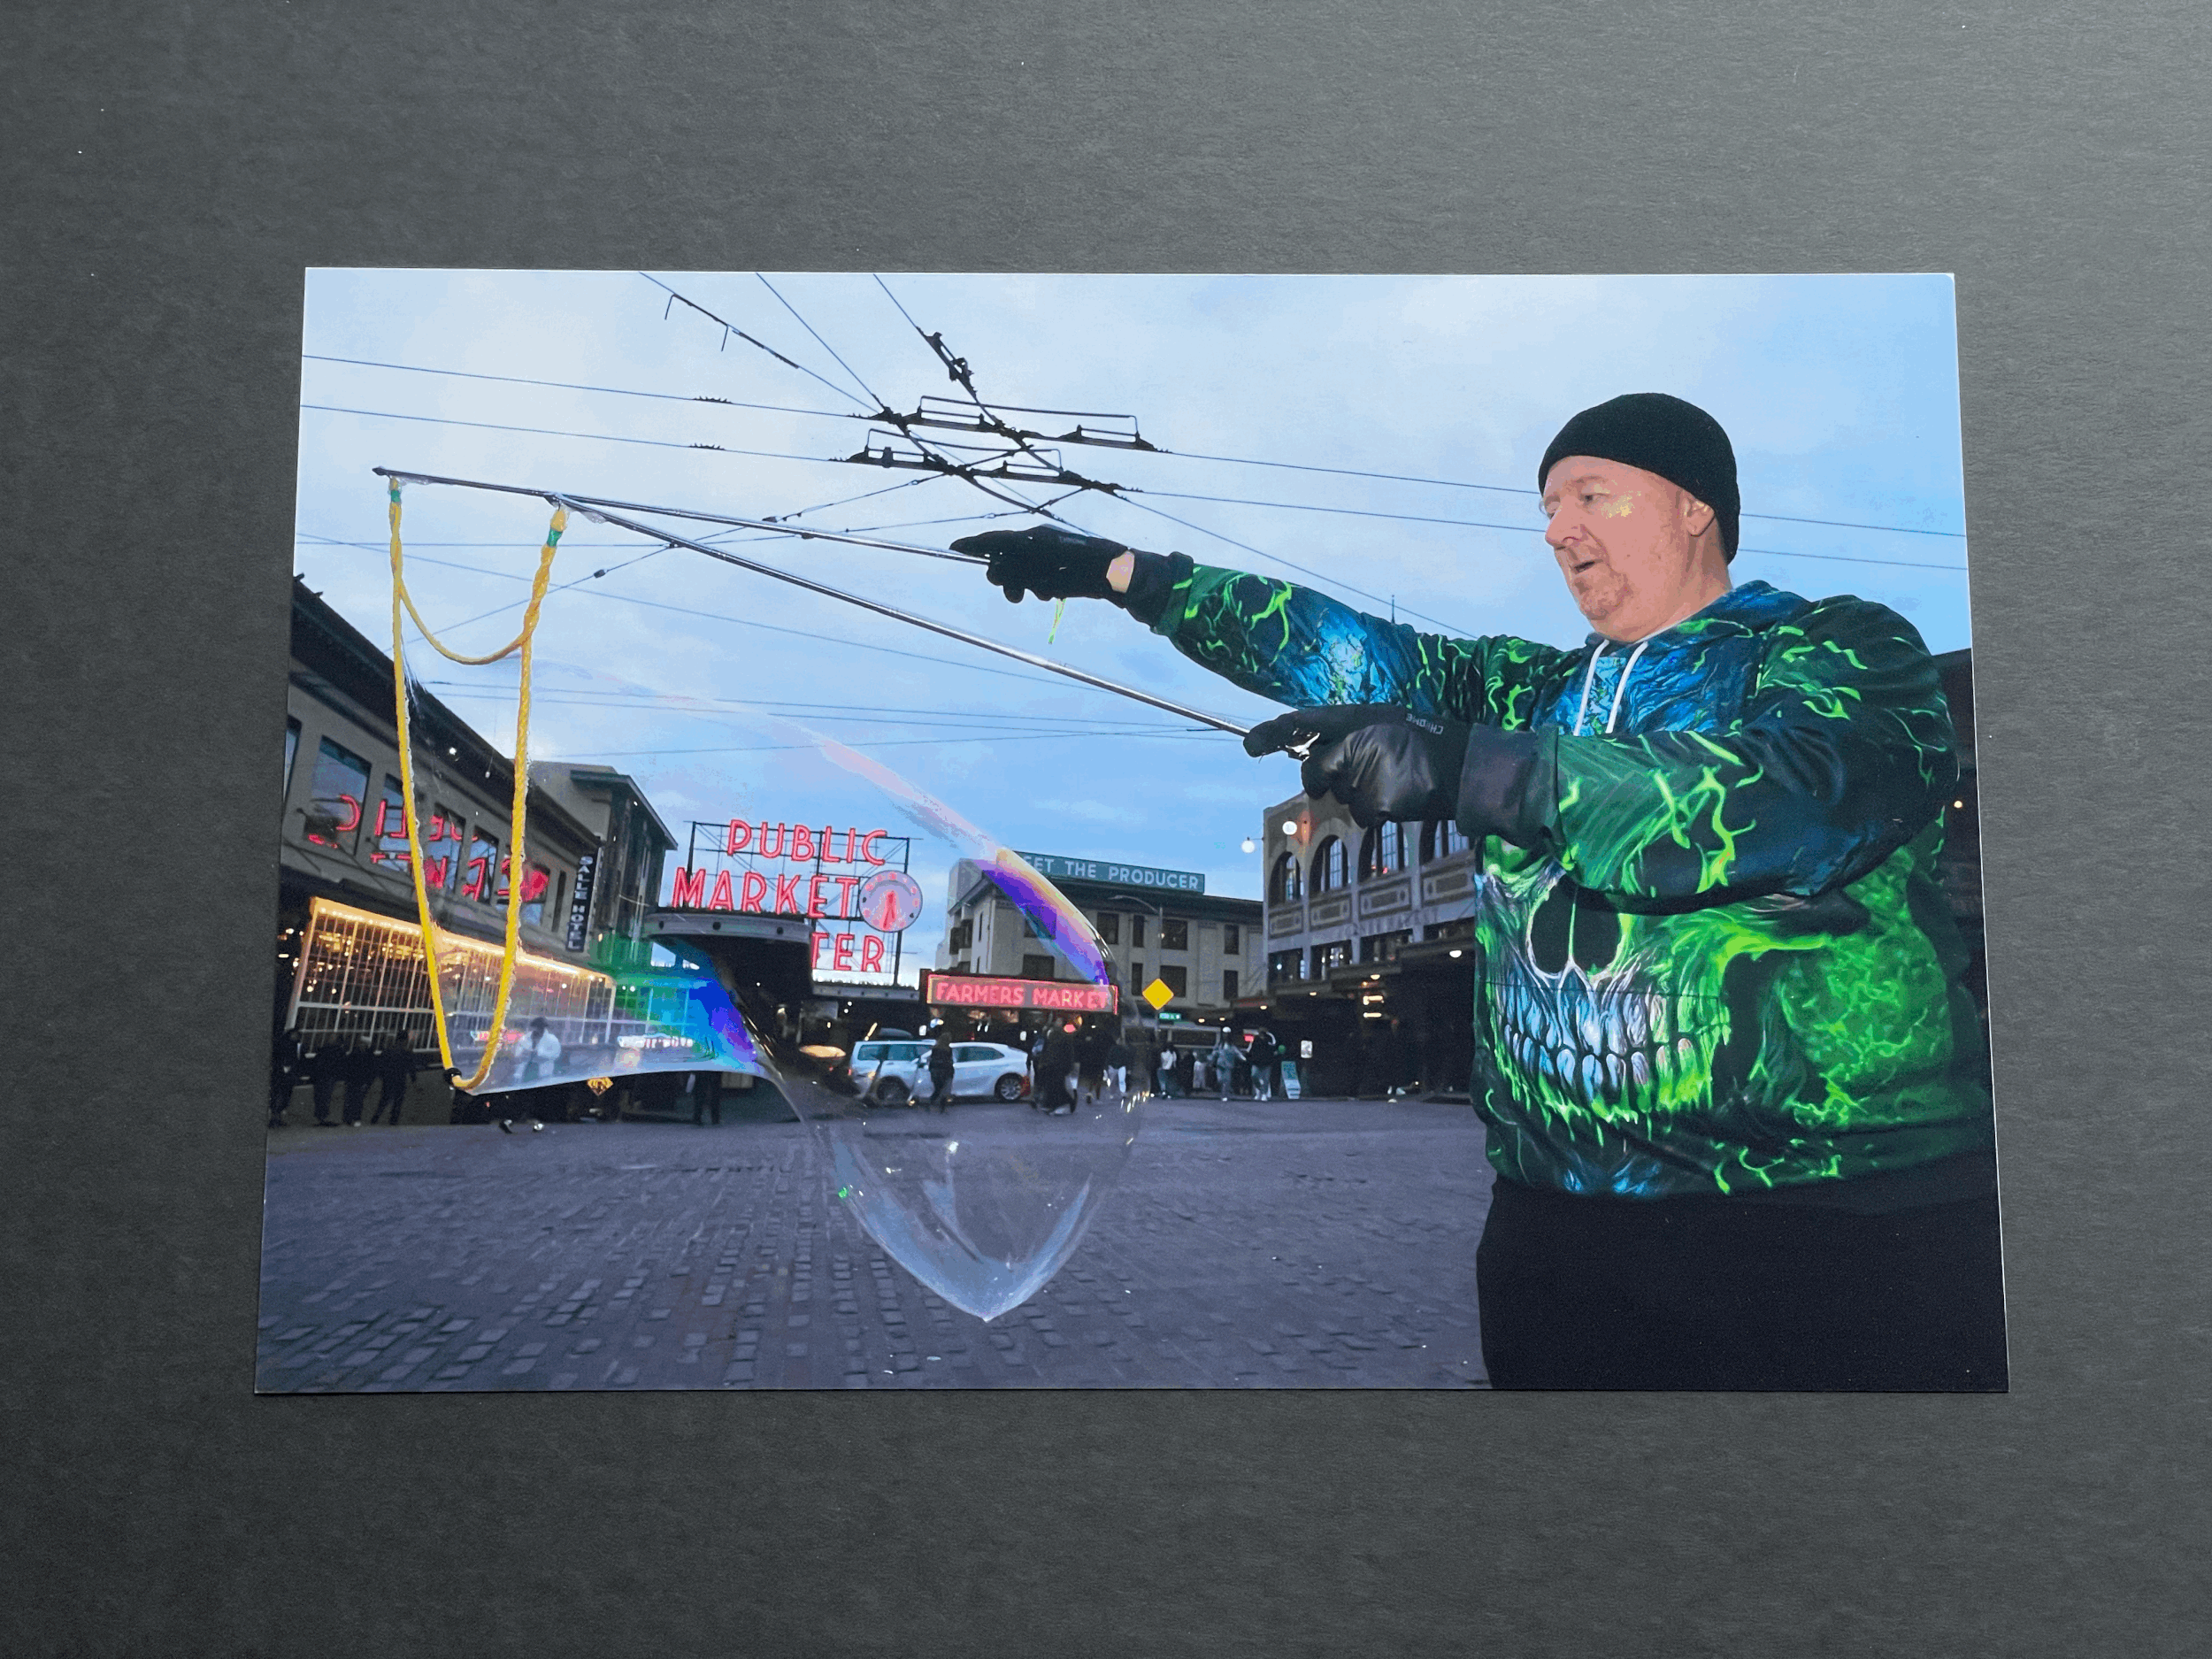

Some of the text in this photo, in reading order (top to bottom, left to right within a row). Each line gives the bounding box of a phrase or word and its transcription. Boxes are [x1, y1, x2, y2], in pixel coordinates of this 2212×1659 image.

[727, 819, 887, 865] PUBLIC
[672, 867, 859, 918] MARKET
[1023, 855, 1200, 890] EET THE PRODUCER
[568, 905, 585, 949] HOTEL
[810, 932, 884, 972] TER
[935, 981, 1108, 1009] FARMERS MARKET
